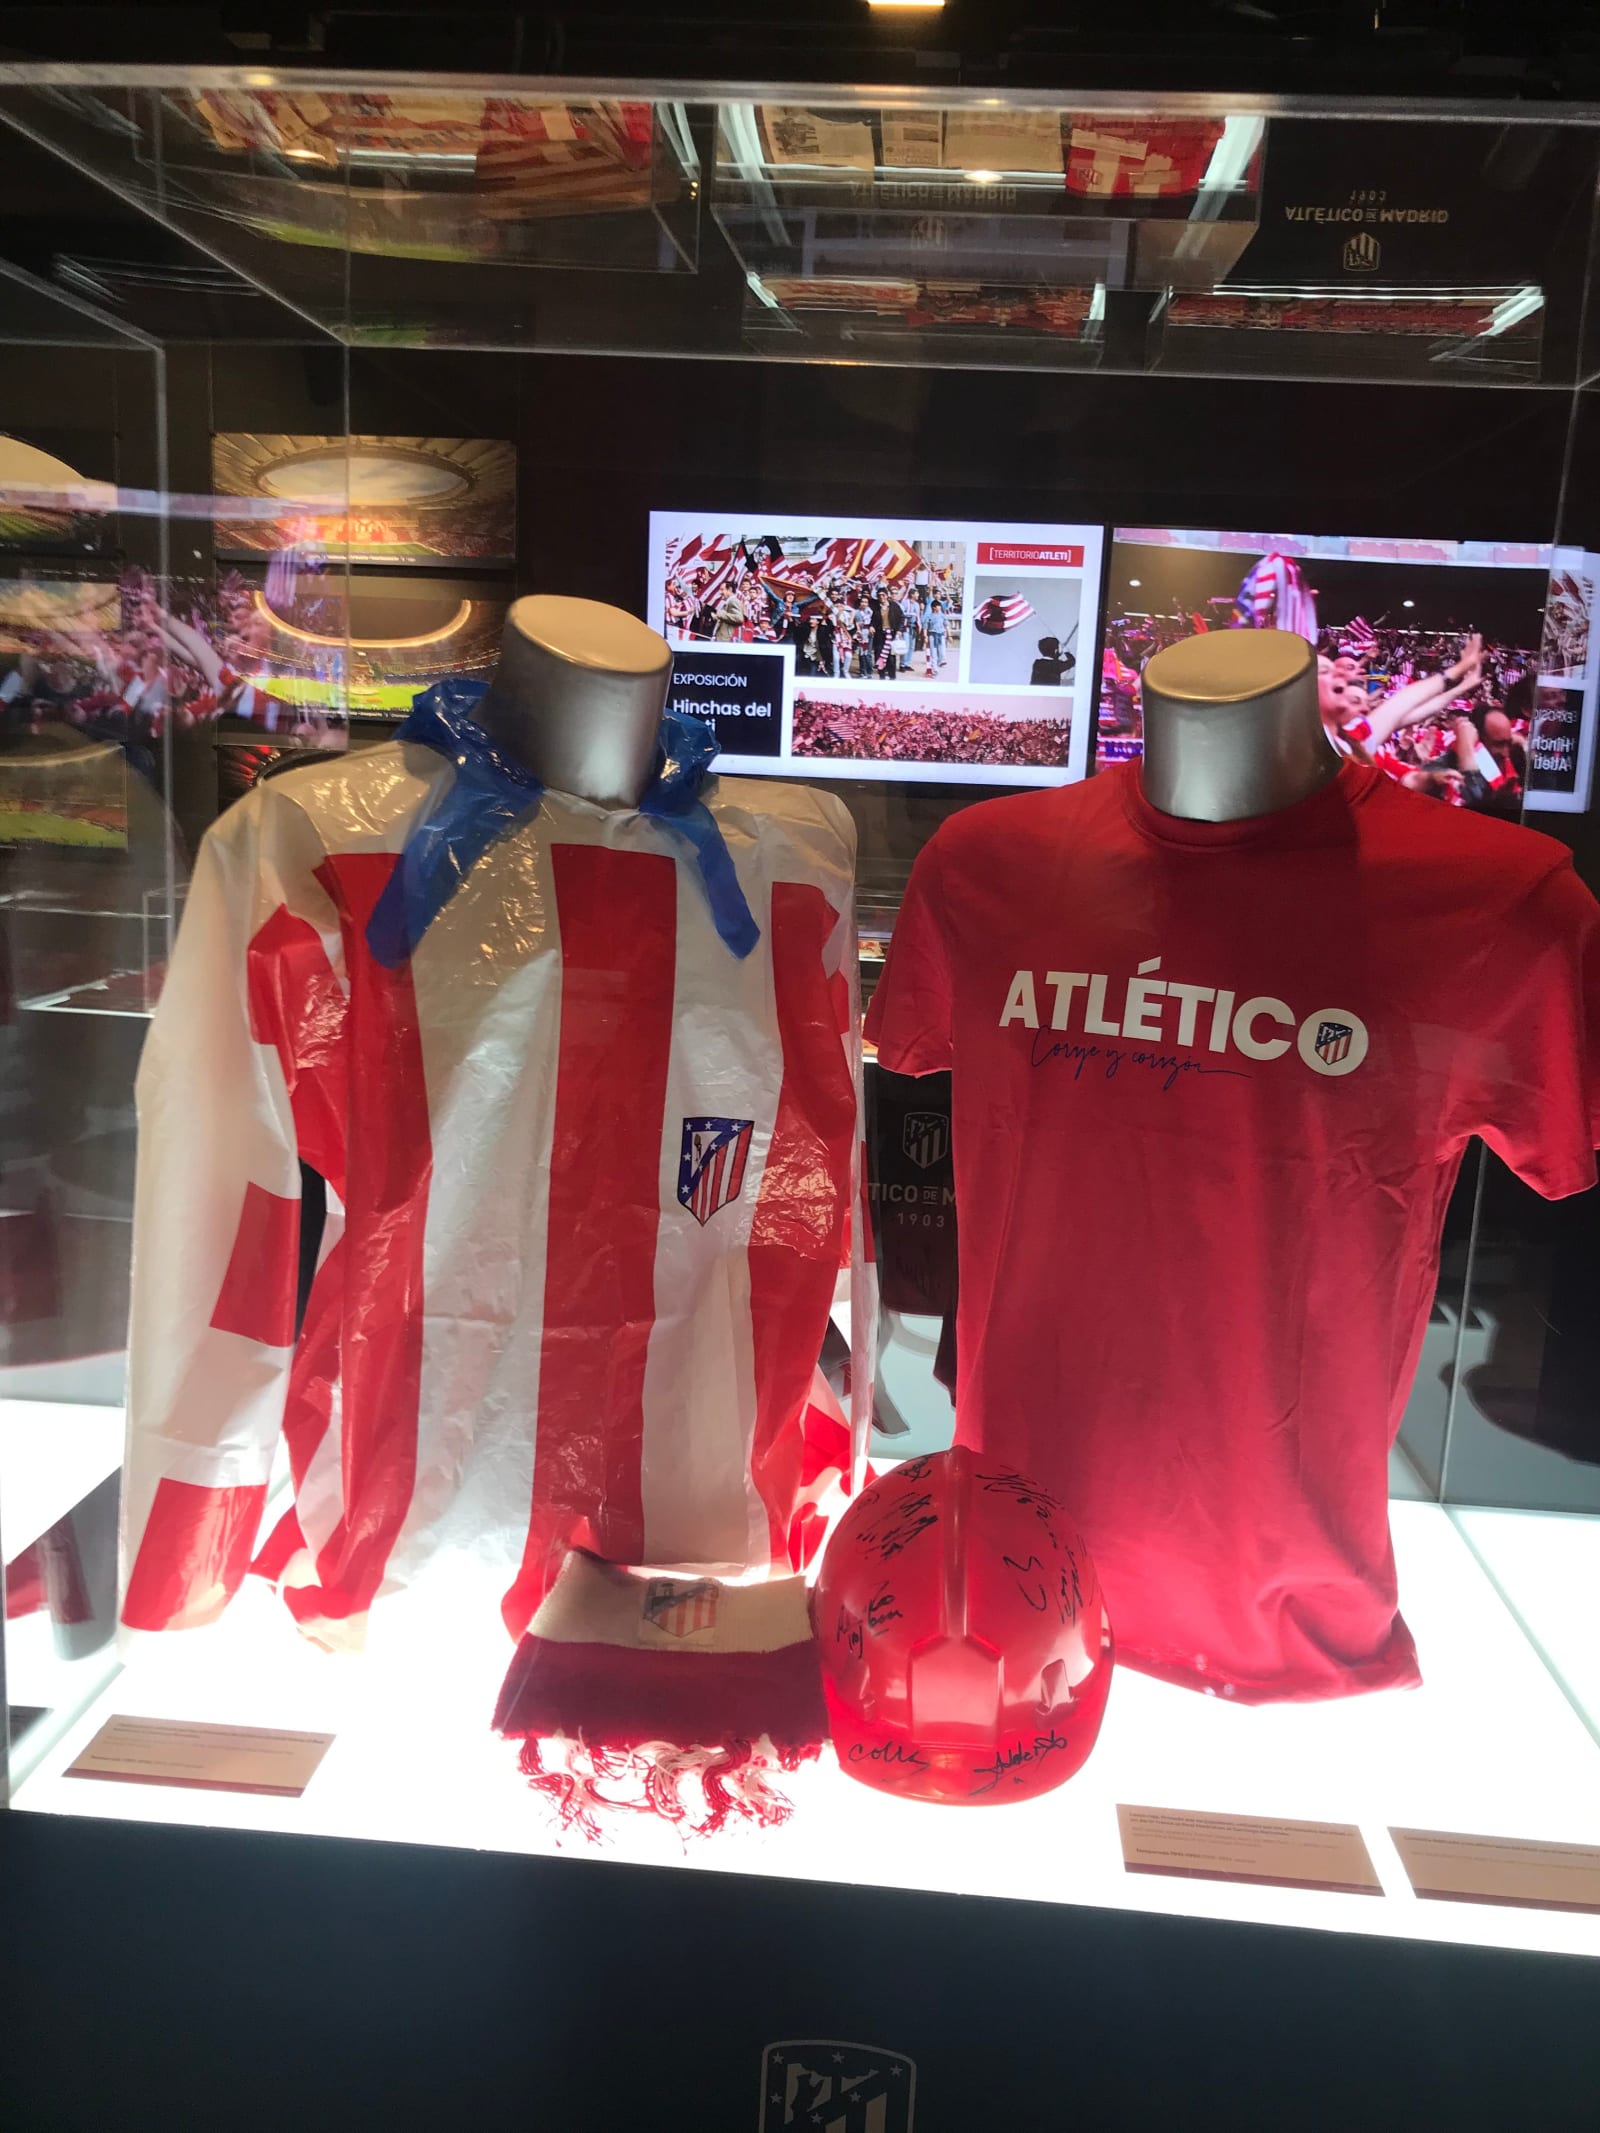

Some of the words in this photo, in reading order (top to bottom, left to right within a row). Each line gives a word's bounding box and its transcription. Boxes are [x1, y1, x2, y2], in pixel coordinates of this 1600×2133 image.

[673, 673, 748, 687] EXPOSICIÓN
[673, 699, 741, 716] Hinchas
[744, 702, 772, 717] del
[999, 956, 1369, 1077] ATLÉTICO
[868, 1182, 919, 1203] TICO
[898, 1212, 945, 1228] 1903
